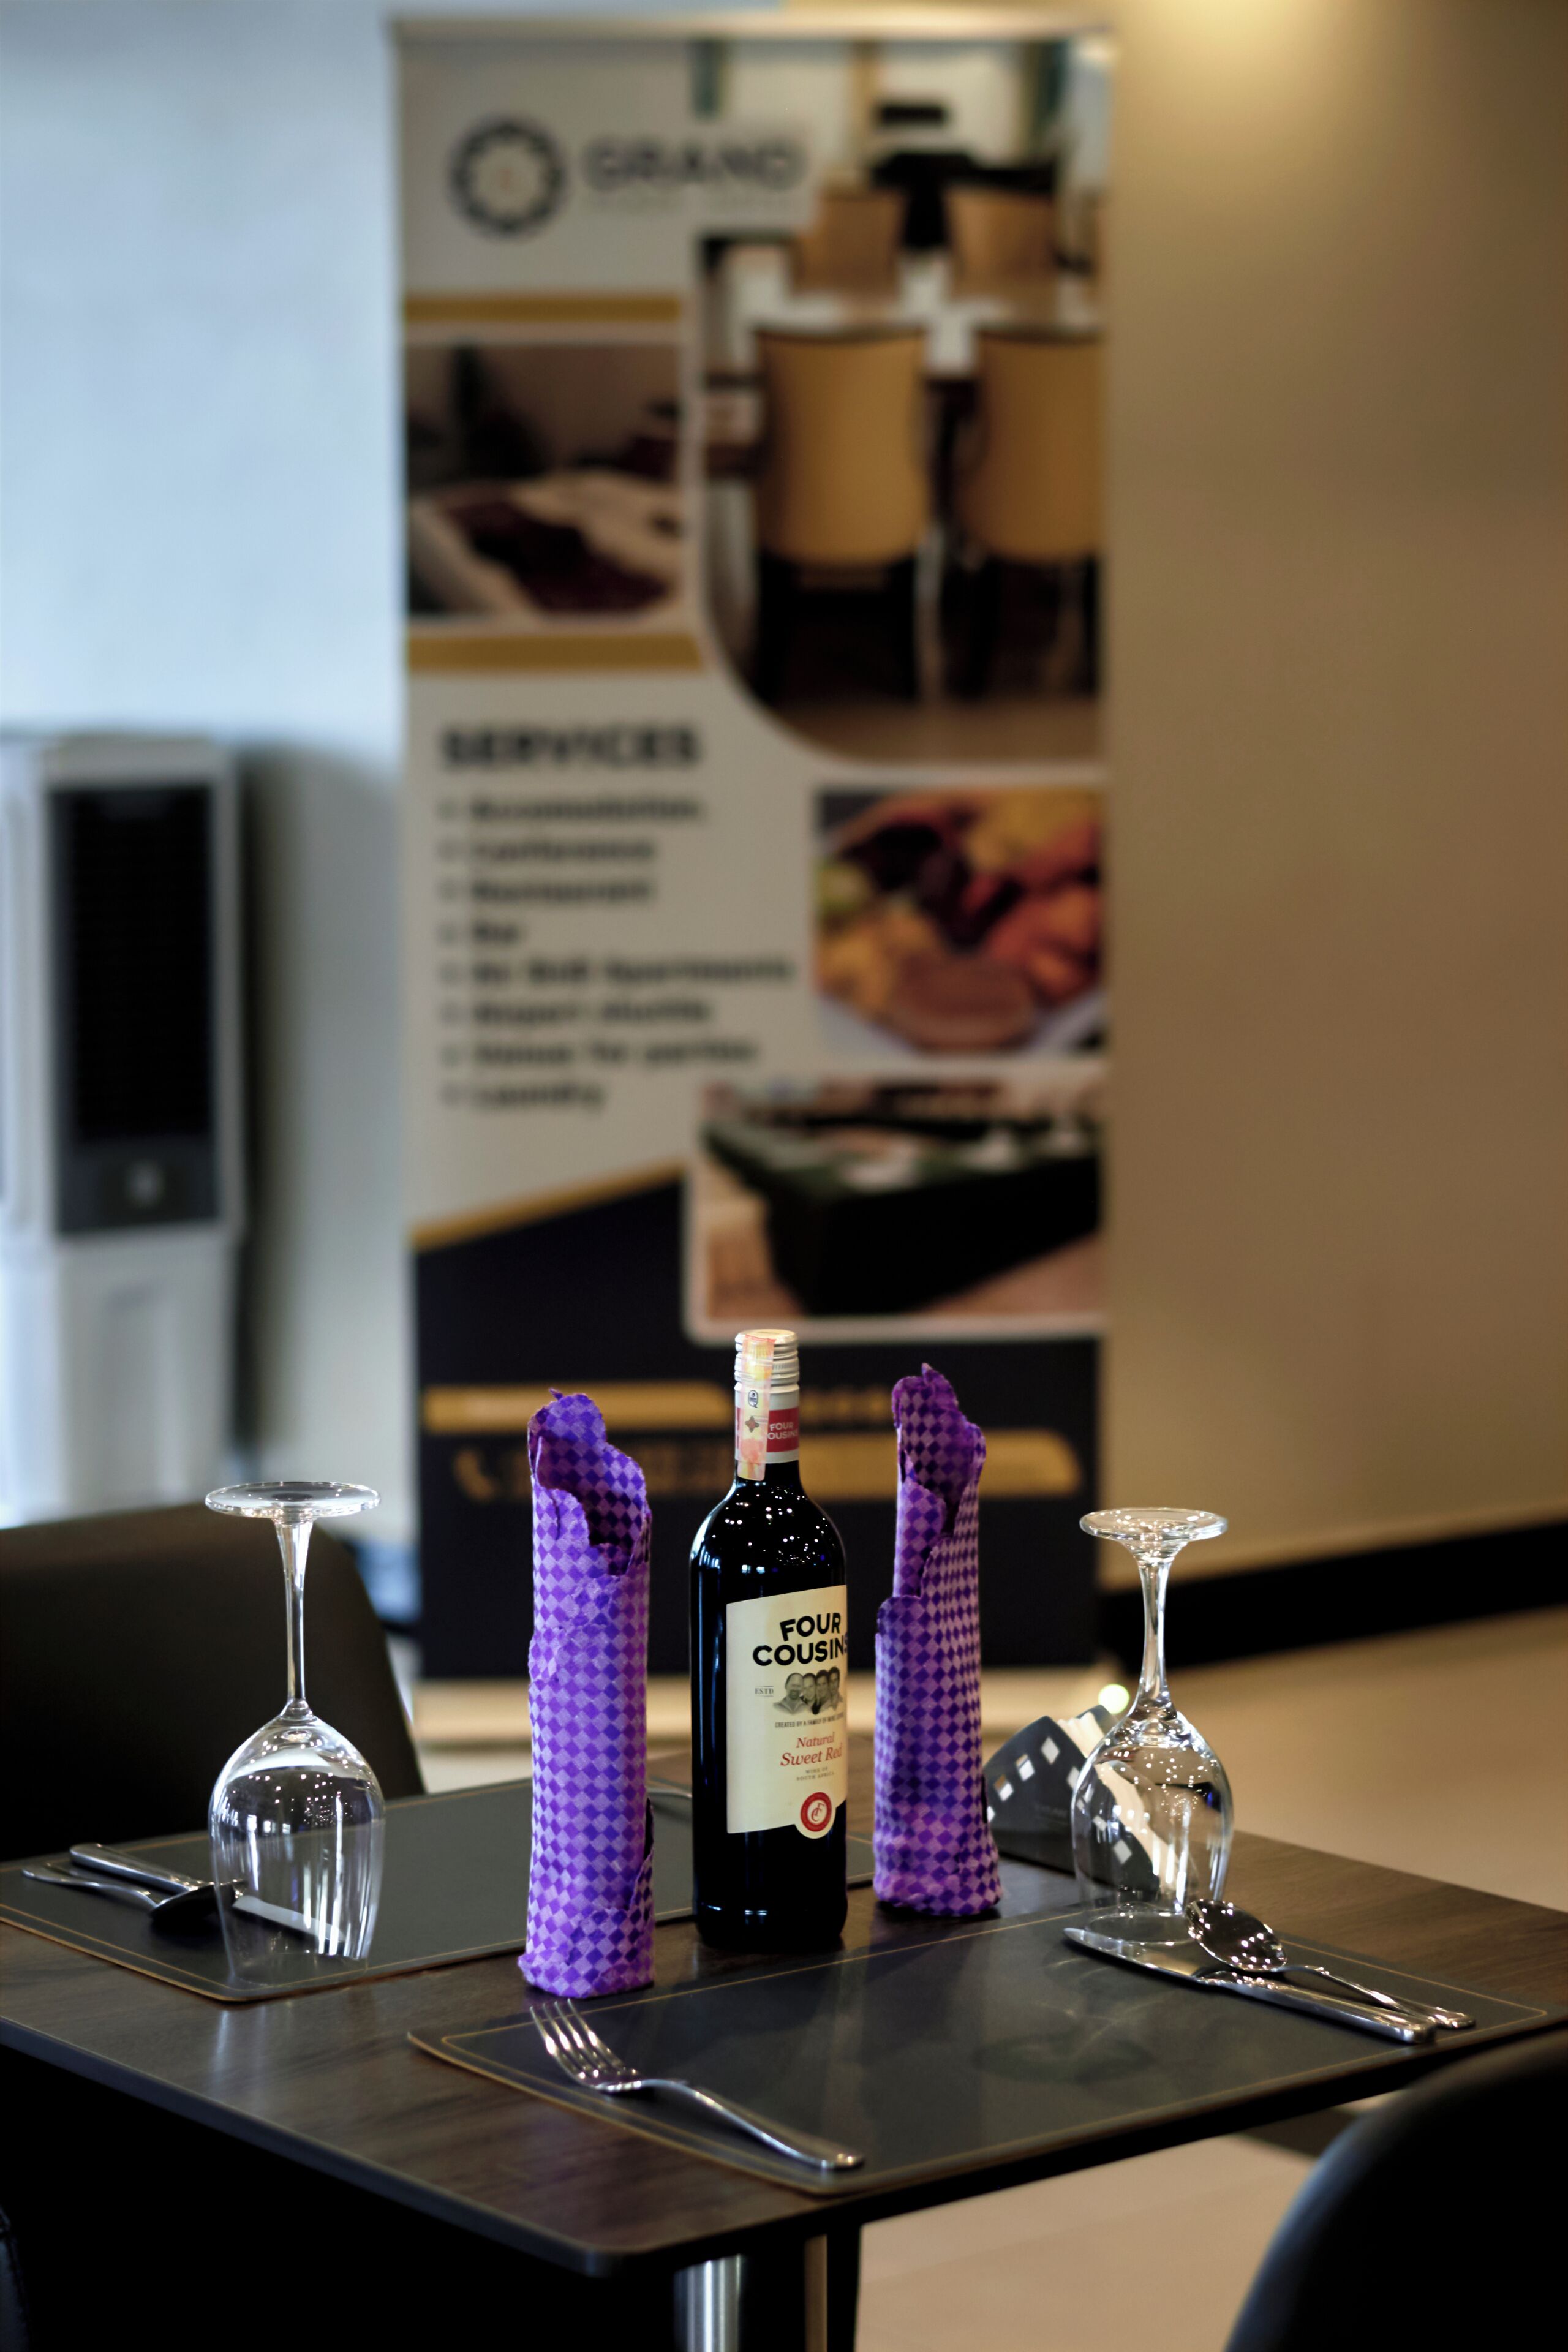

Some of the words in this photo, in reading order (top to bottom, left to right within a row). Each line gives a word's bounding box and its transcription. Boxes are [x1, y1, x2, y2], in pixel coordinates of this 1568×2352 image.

[584, 137, 802, 187] GRAND
[439, 725, 702, 768] SERVICES
[470, 876, 655, 907] Restaurant
[769, 1421, 794, 1431] FOUR
[780, 1612, 841, 1642] FOUR
[780, 1751, 823, 1766] Sweet
[825, 1742, 843, 1761] Red
[796, 1732, 835, 1749] Natural
